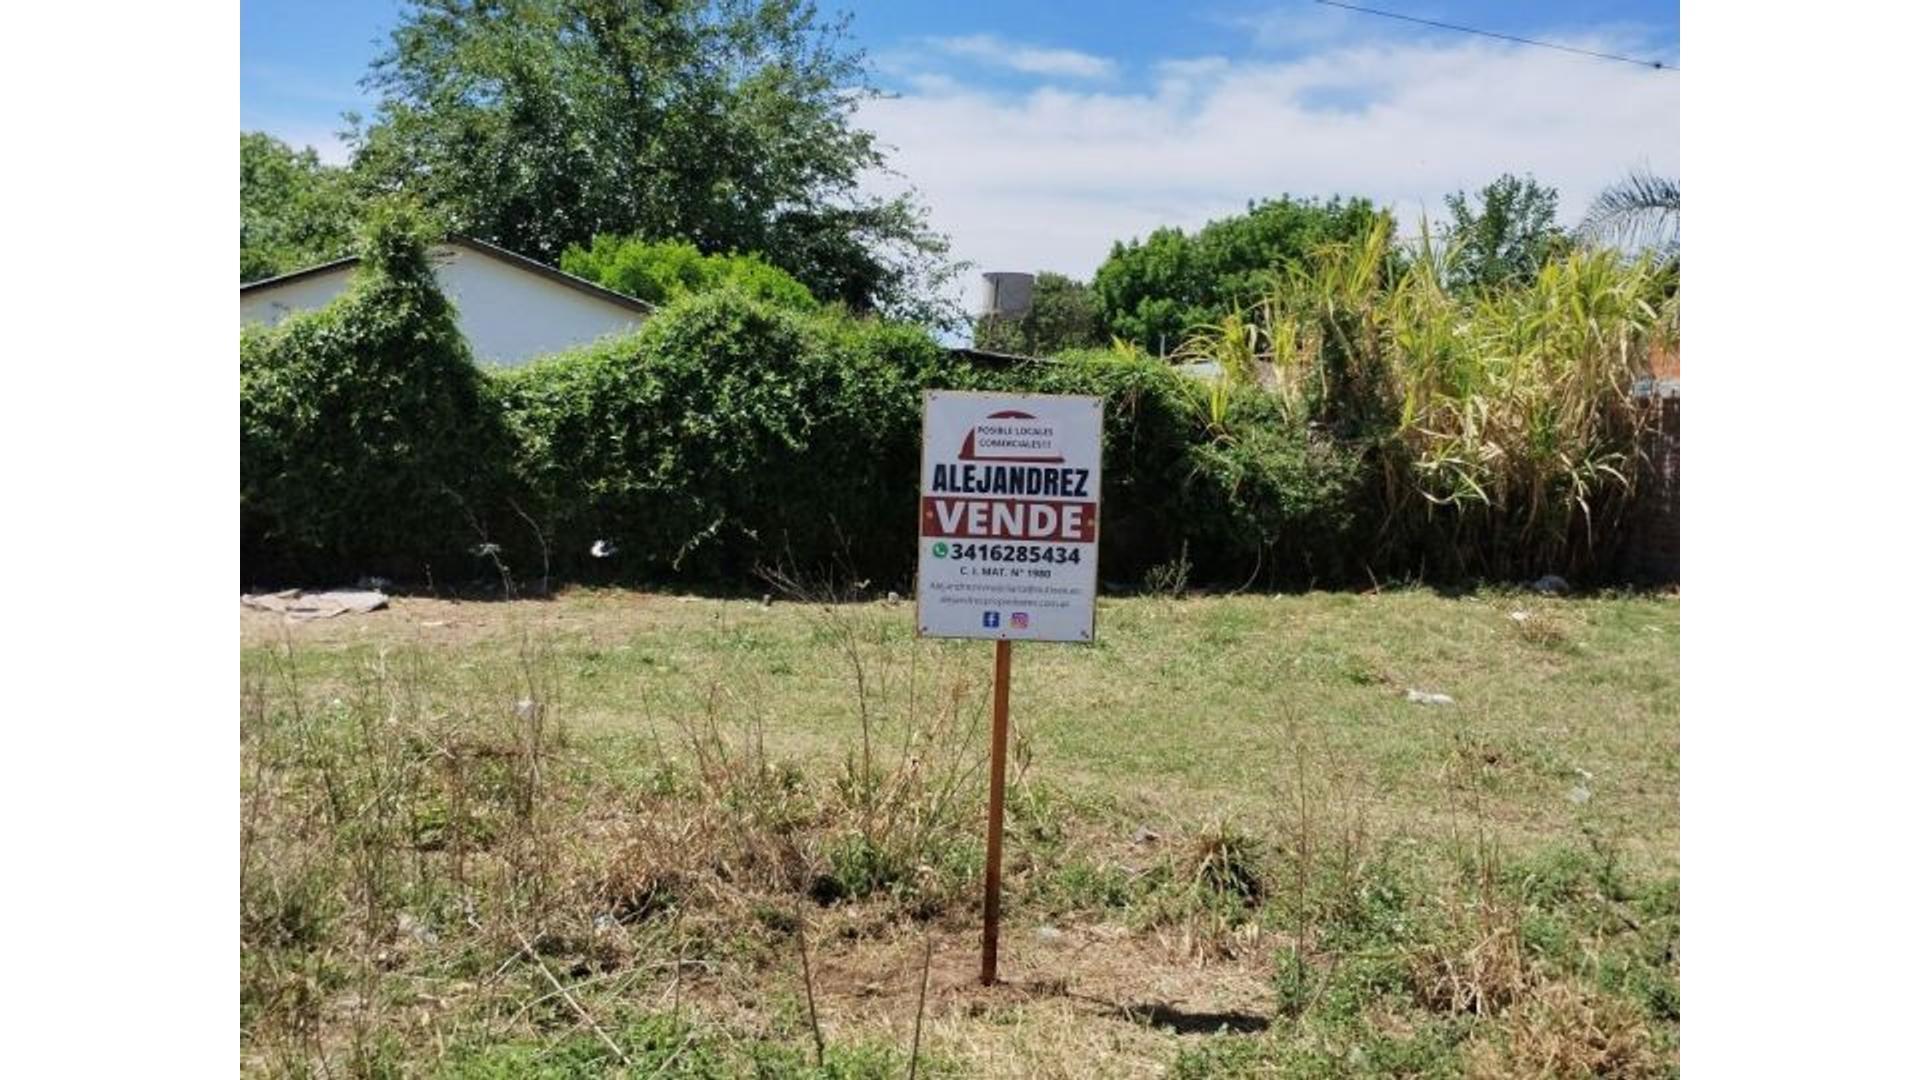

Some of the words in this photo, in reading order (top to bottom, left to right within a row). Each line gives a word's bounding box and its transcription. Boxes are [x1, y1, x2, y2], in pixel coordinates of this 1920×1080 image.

[977, 426, 1012, 435] POSIBLE
[1015, 427, 1053, 436] LOCALES
[932, 464, 1089, 497] ALEJANDREZ
[935, 501, 1083, 539] VENDE
[951, 543, 1081, 564] 3416285434
[982, 567, 1007, 577] MAT.
